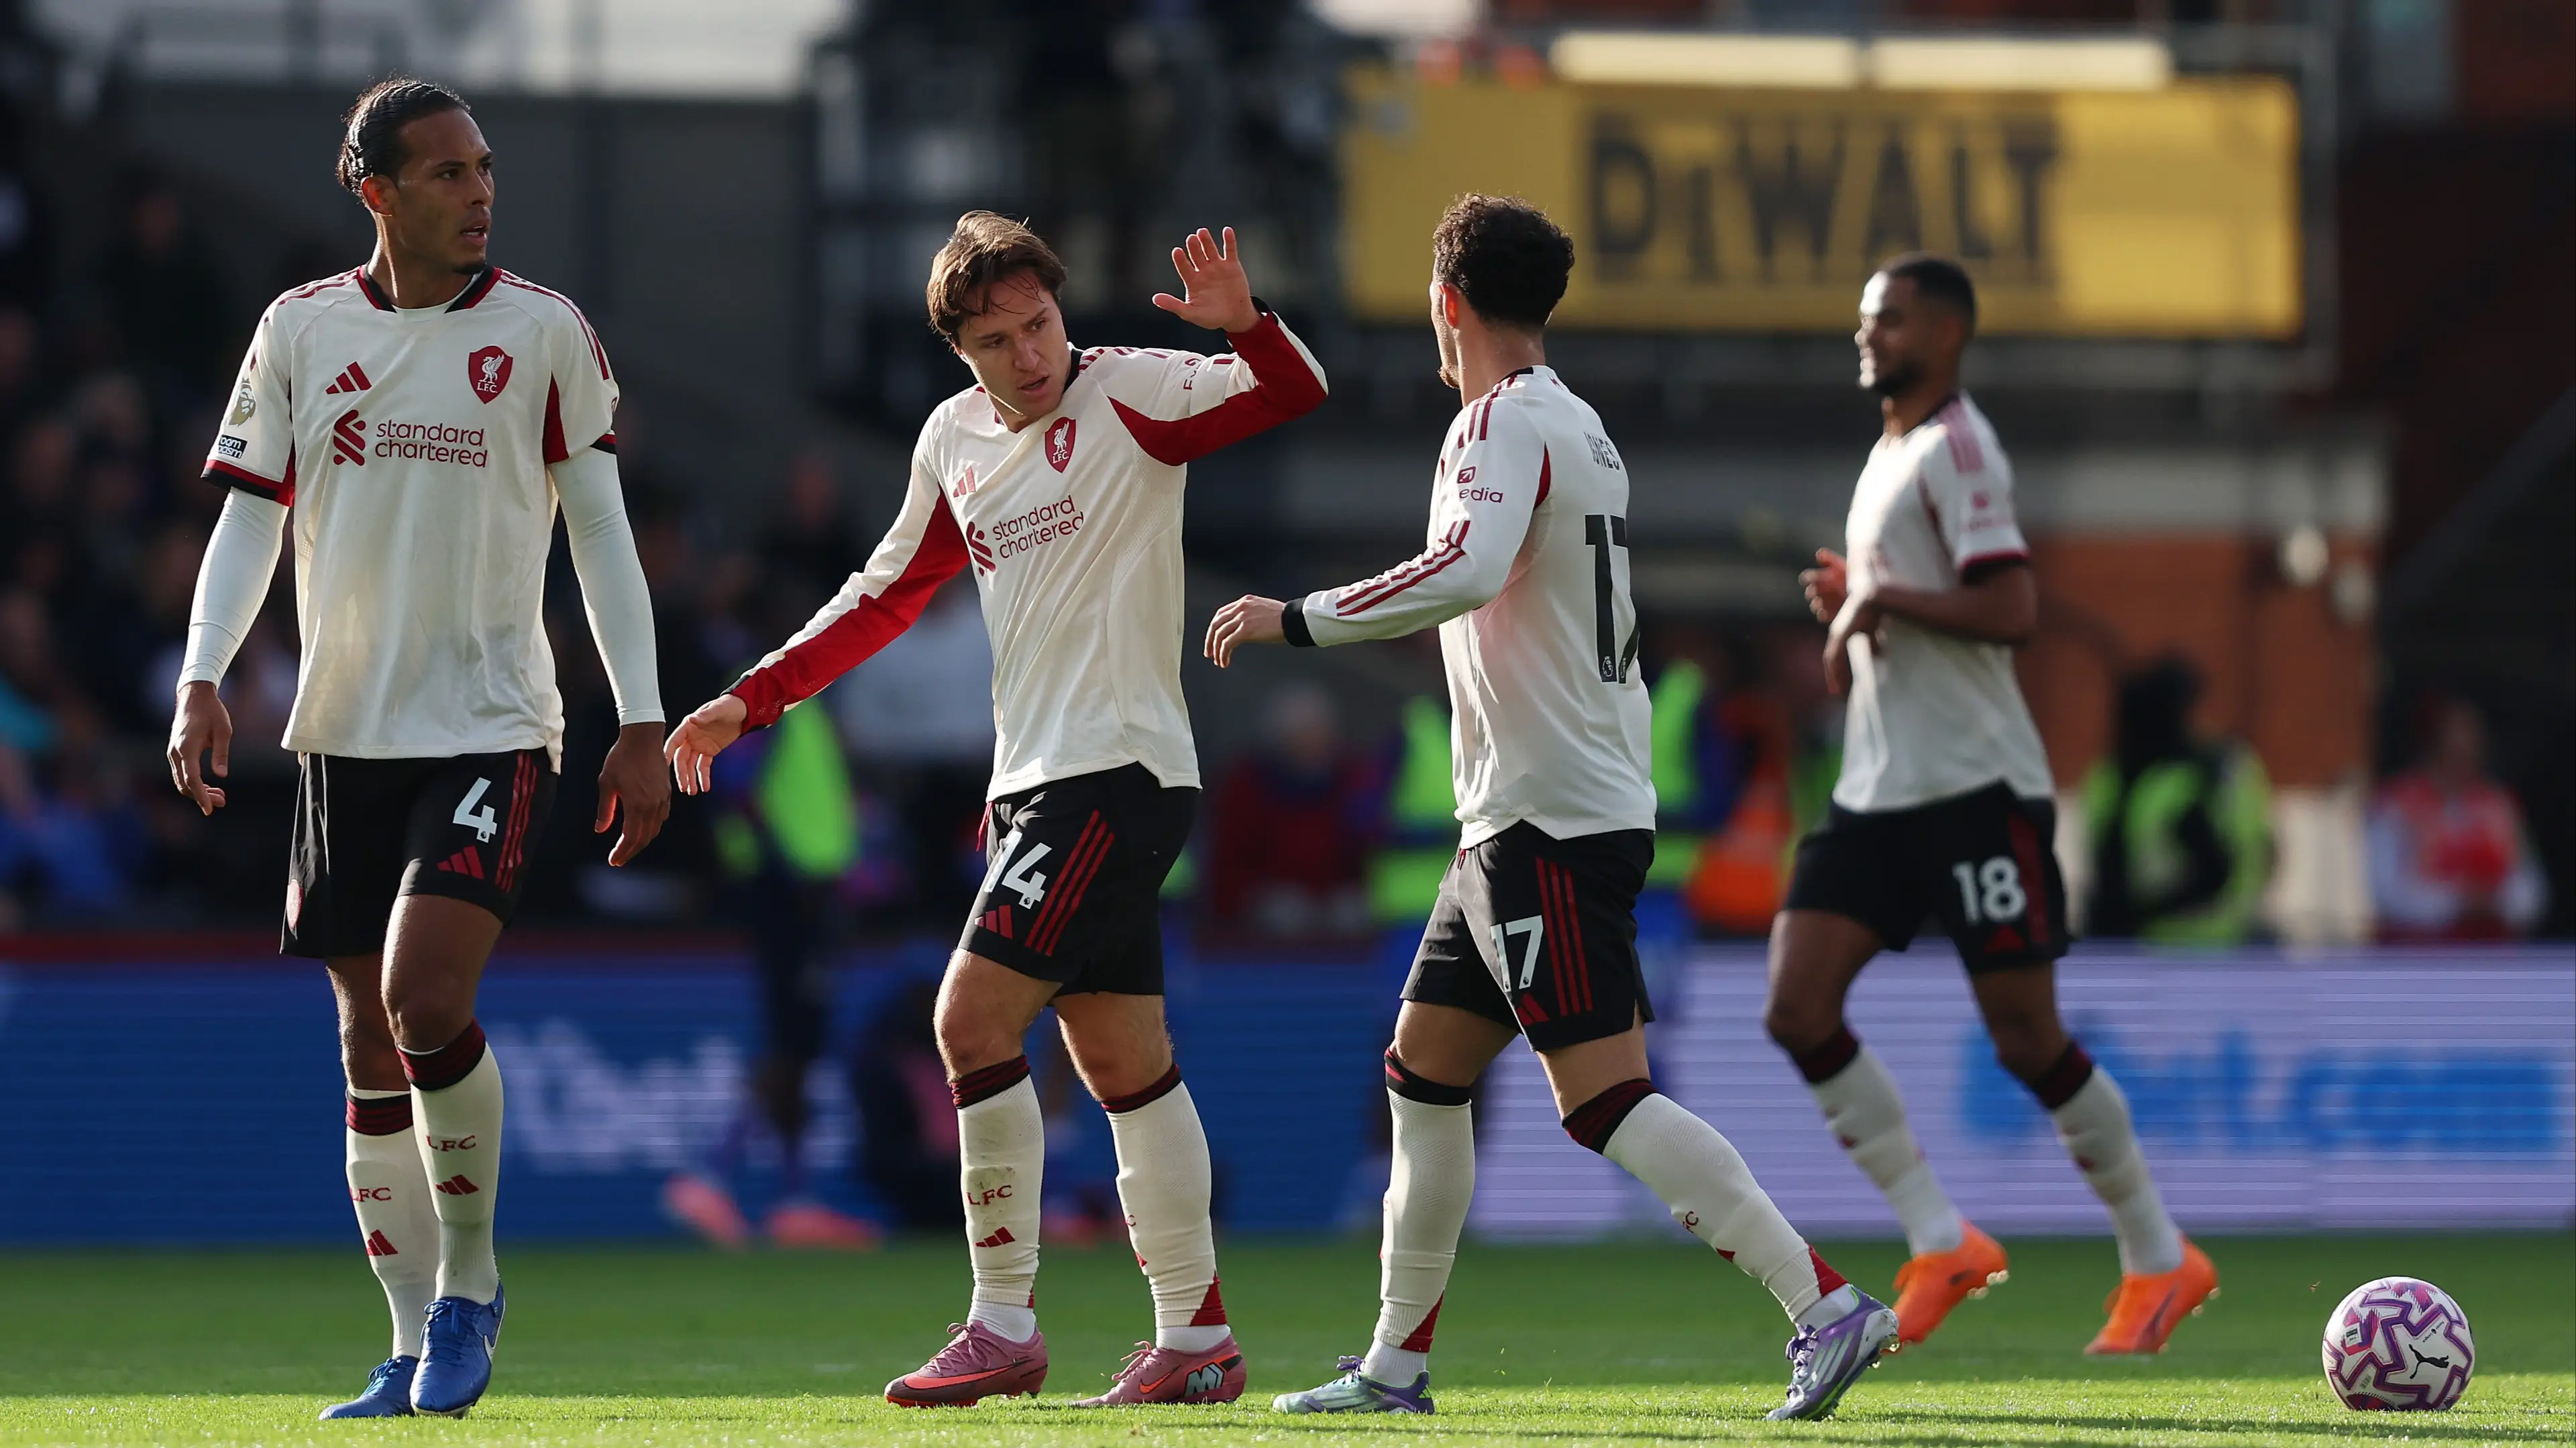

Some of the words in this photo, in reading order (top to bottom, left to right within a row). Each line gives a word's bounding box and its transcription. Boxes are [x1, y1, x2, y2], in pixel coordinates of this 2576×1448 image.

[219, 437, 241, 449] oom
[376, 419, 484, 447] standard
[375, 439, 488, 468] chartered
[1459, 487, 1503, 503] edia
[992, 494, 1076, 541] standard
[999, 511, 1084, 559] chartered
[452, 777, 497, 843] 4
[983, 830, 1053, 909] 14
[1951, 855, 2027, 926] 18
[1490, 915, 1544, 993] 17
[427, 1135, 476, 1152] LFC
[350, 1187, 392, 1203] LFC
[967, 1184, 1012, 1205] LFC
